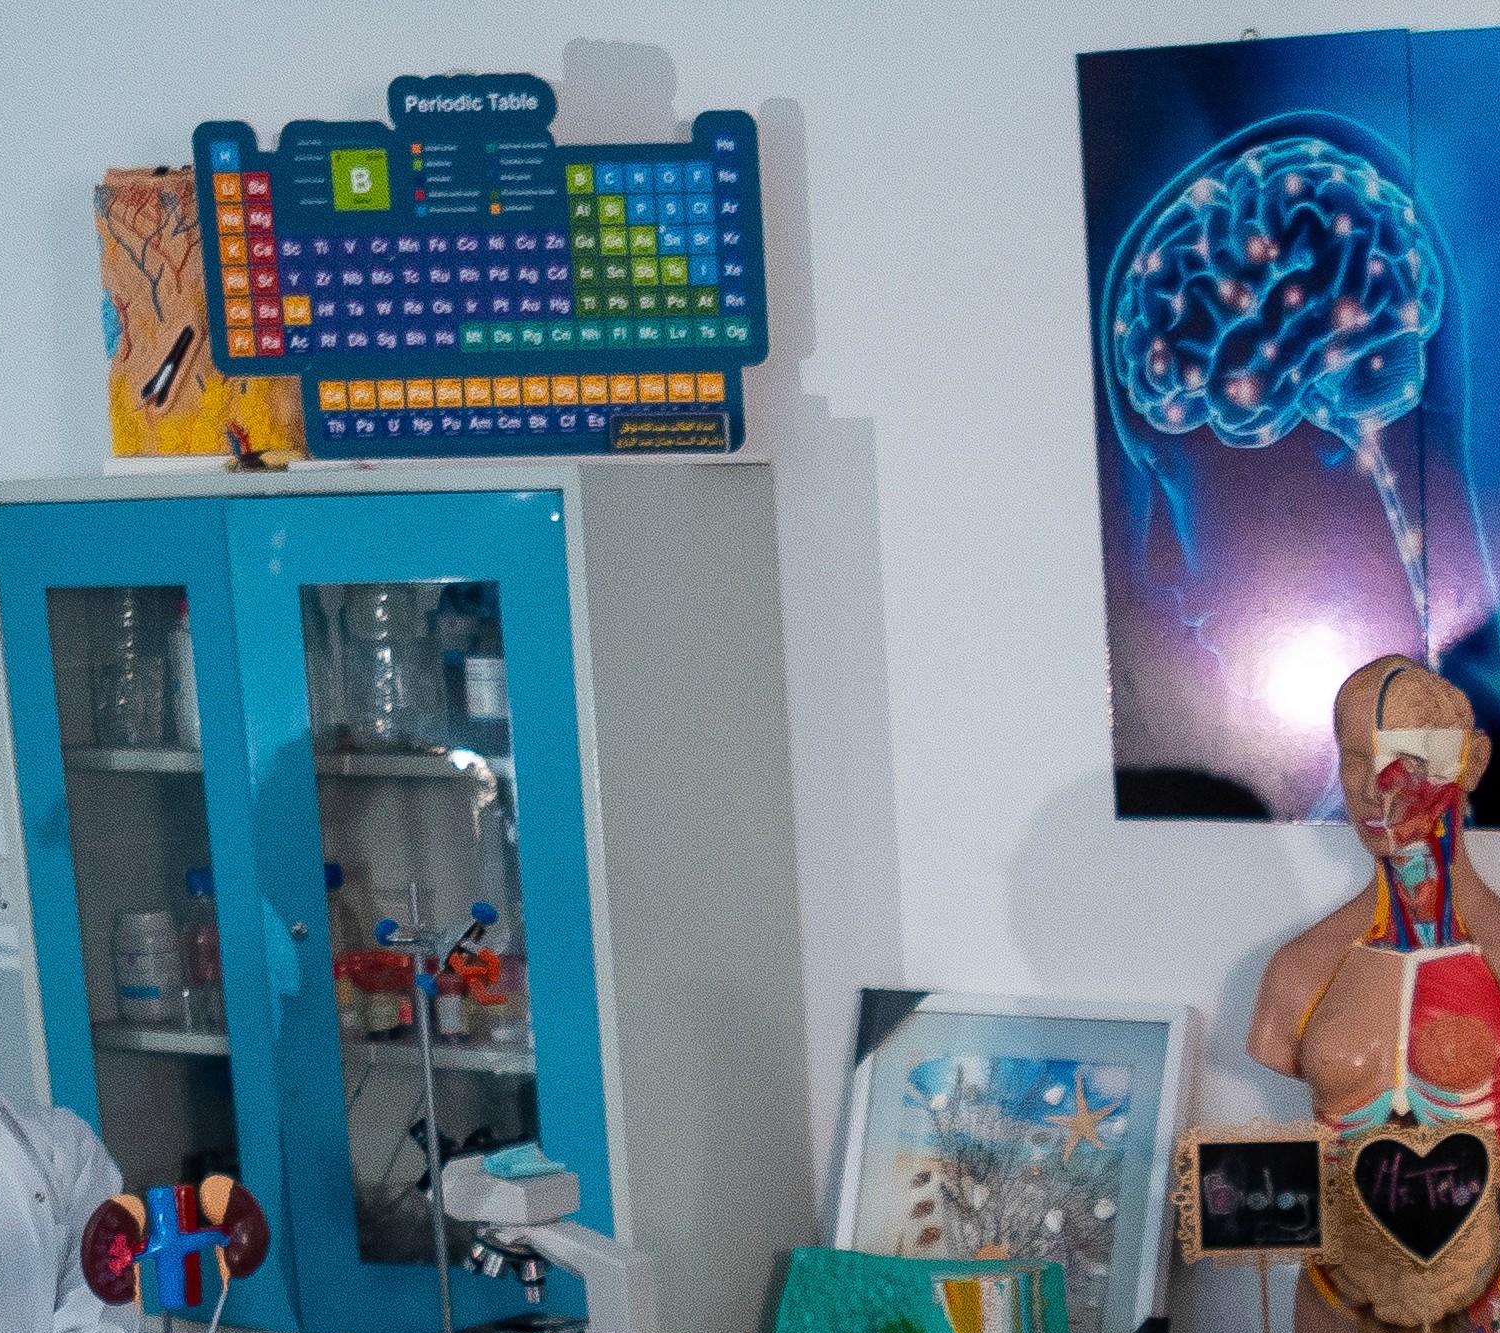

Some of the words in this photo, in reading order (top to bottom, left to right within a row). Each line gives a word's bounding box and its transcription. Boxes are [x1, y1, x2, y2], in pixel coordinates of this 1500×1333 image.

[404, 94, 483, 113] Periodic
[487, 92, 539, 111] Table
[350, 167, 372, 193] B
